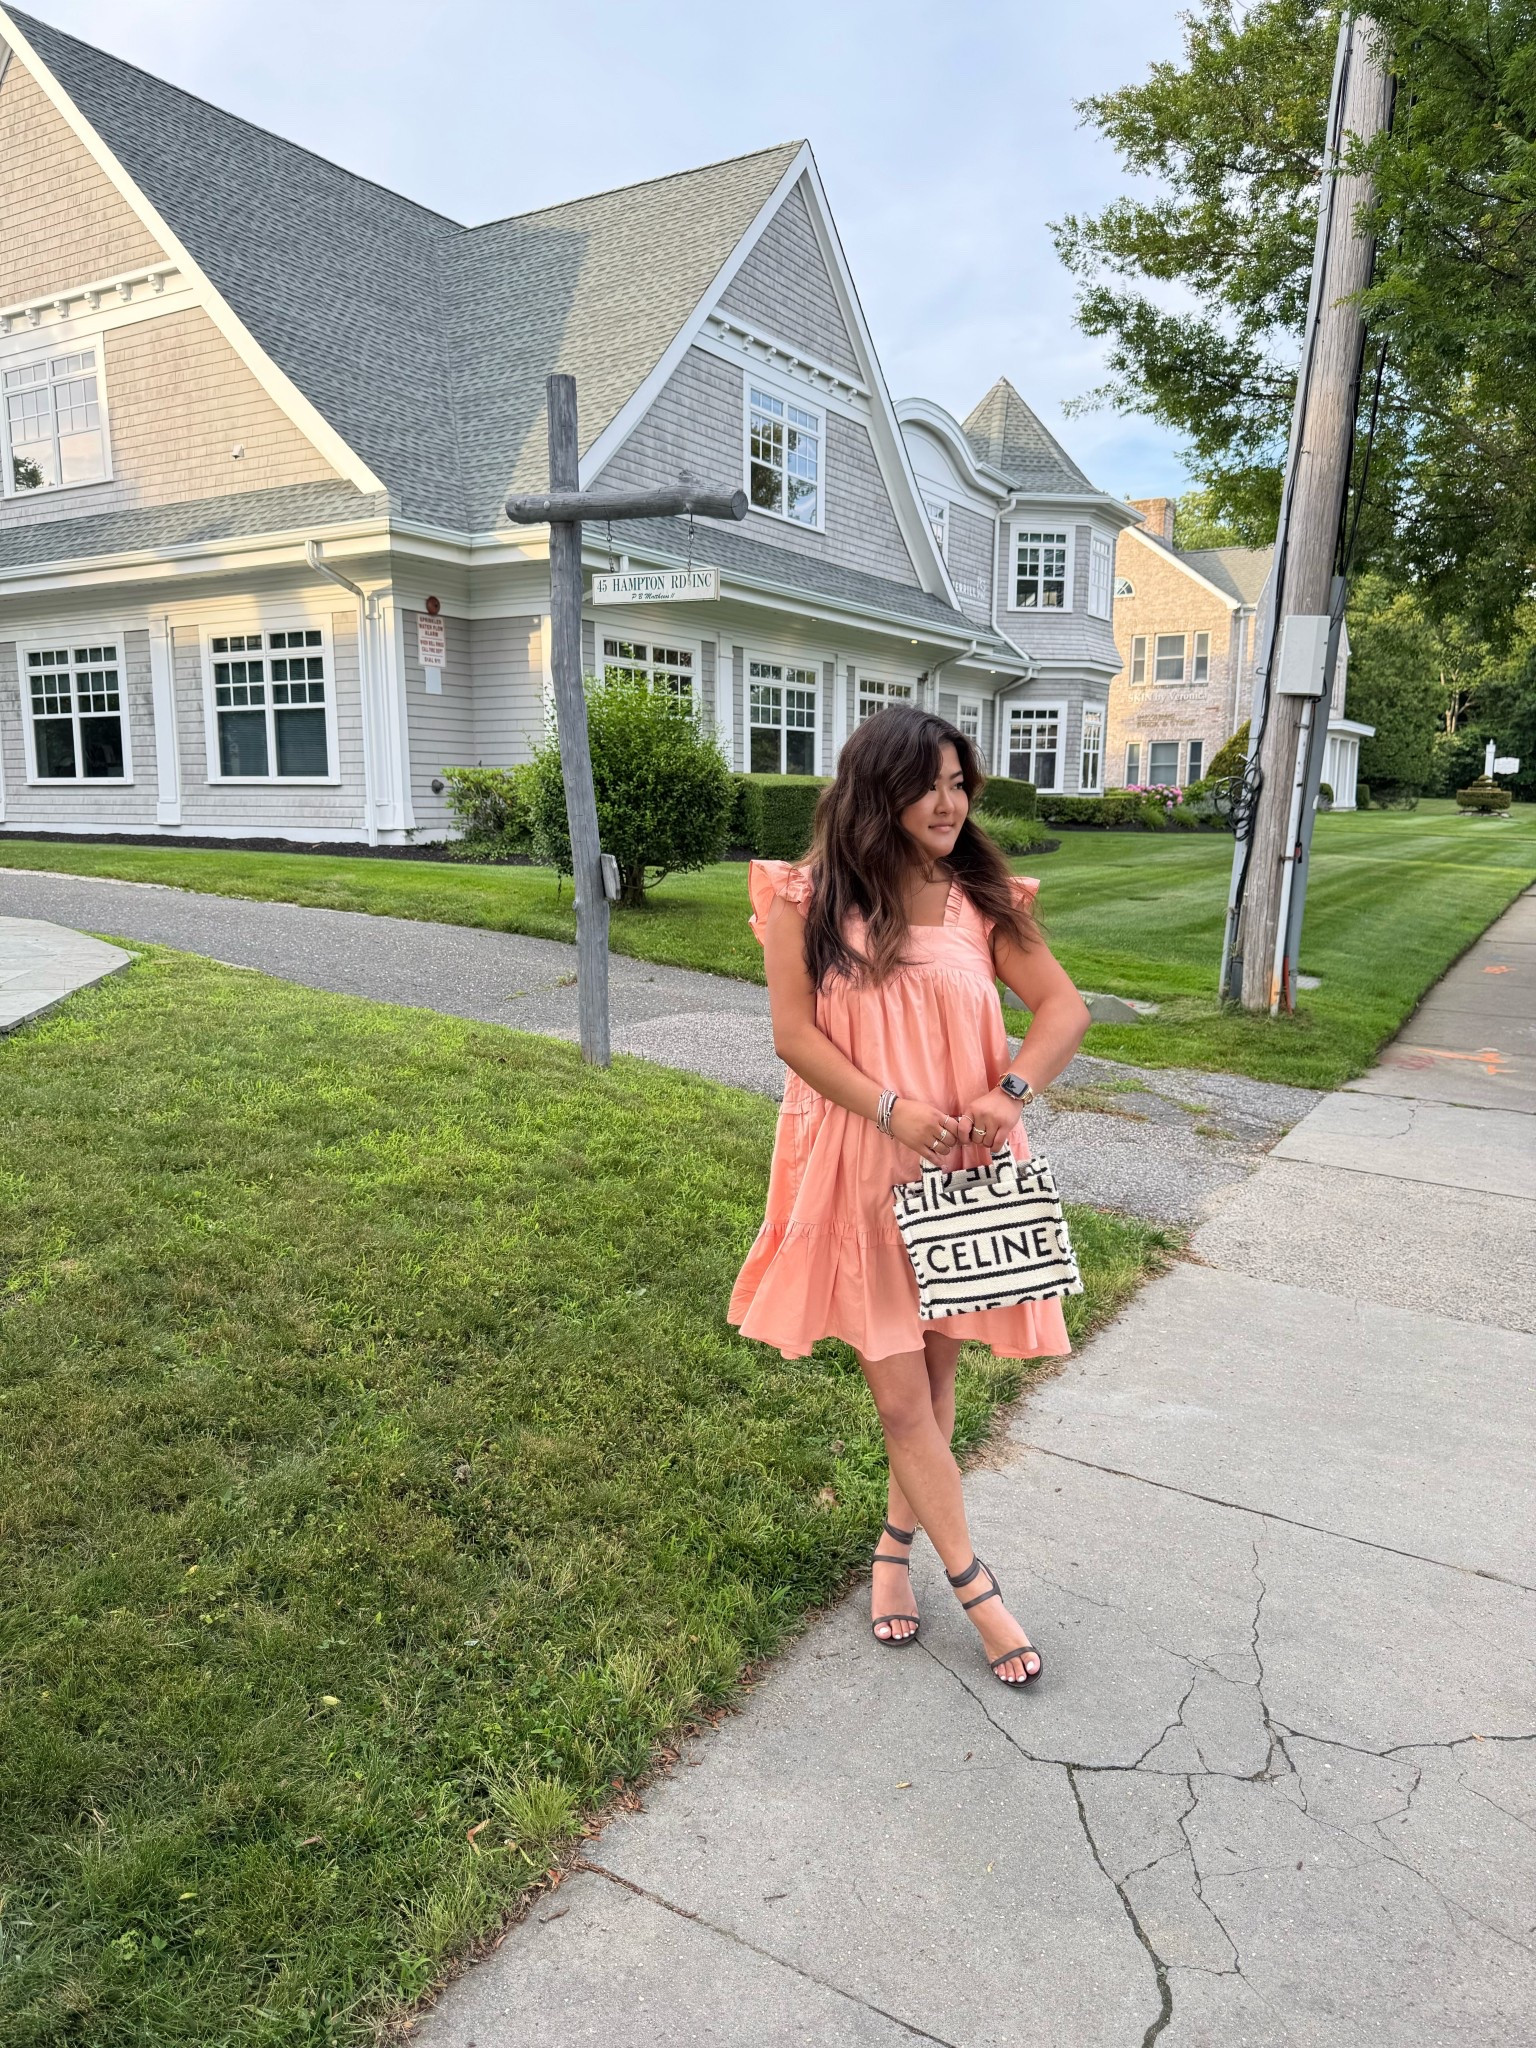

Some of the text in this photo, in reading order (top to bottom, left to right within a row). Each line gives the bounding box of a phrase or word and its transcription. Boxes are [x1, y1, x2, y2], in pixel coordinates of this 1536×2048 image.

[596, 573, 712, 592] 45 HAMPTON RD INC
[926, 1227, 1052, 1274] CELINE
